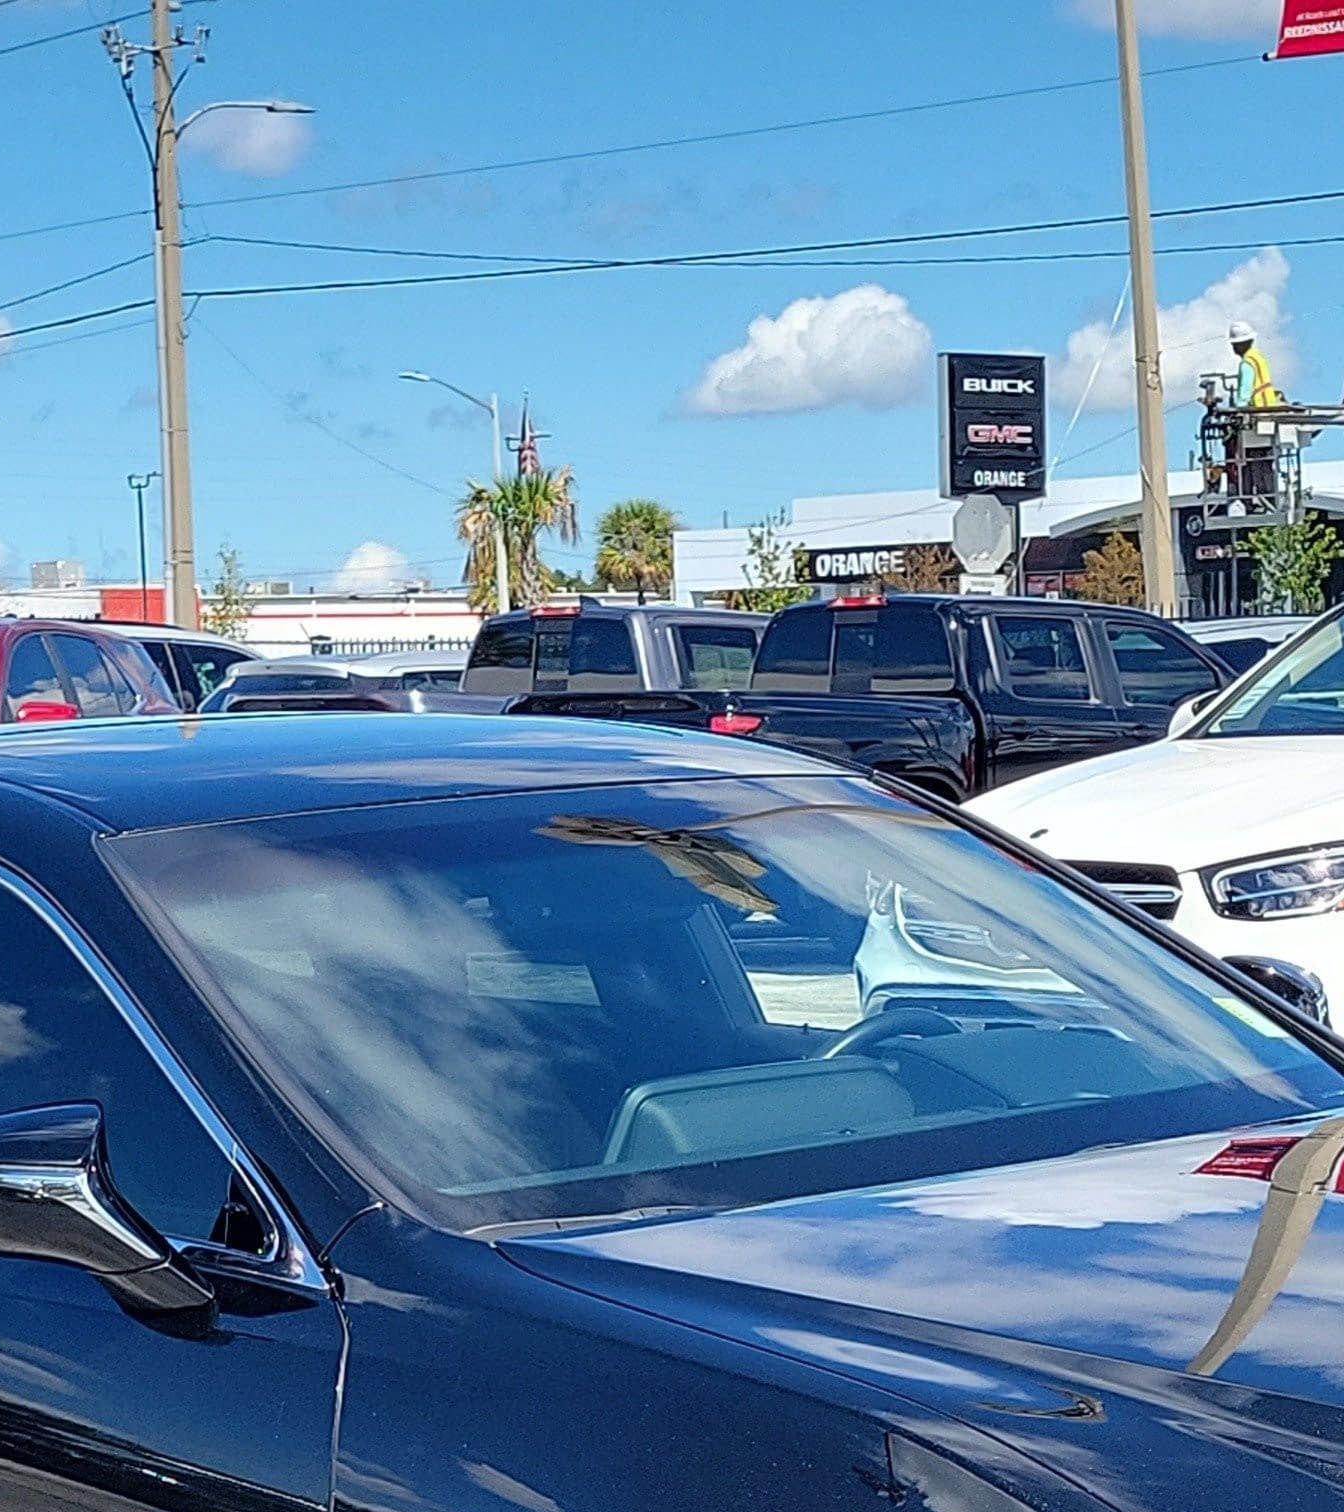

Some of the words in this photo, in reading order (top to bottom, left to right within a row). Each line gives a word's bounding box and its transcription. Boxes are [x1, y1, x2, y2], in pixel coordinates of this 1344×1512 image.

[963, 378, 1035, 393] BUICK
[967, 425, 1033, 443] GMC
[974, 470, 1026, 487] ORANGE
[816, 551, 905, 577] ORANGE
